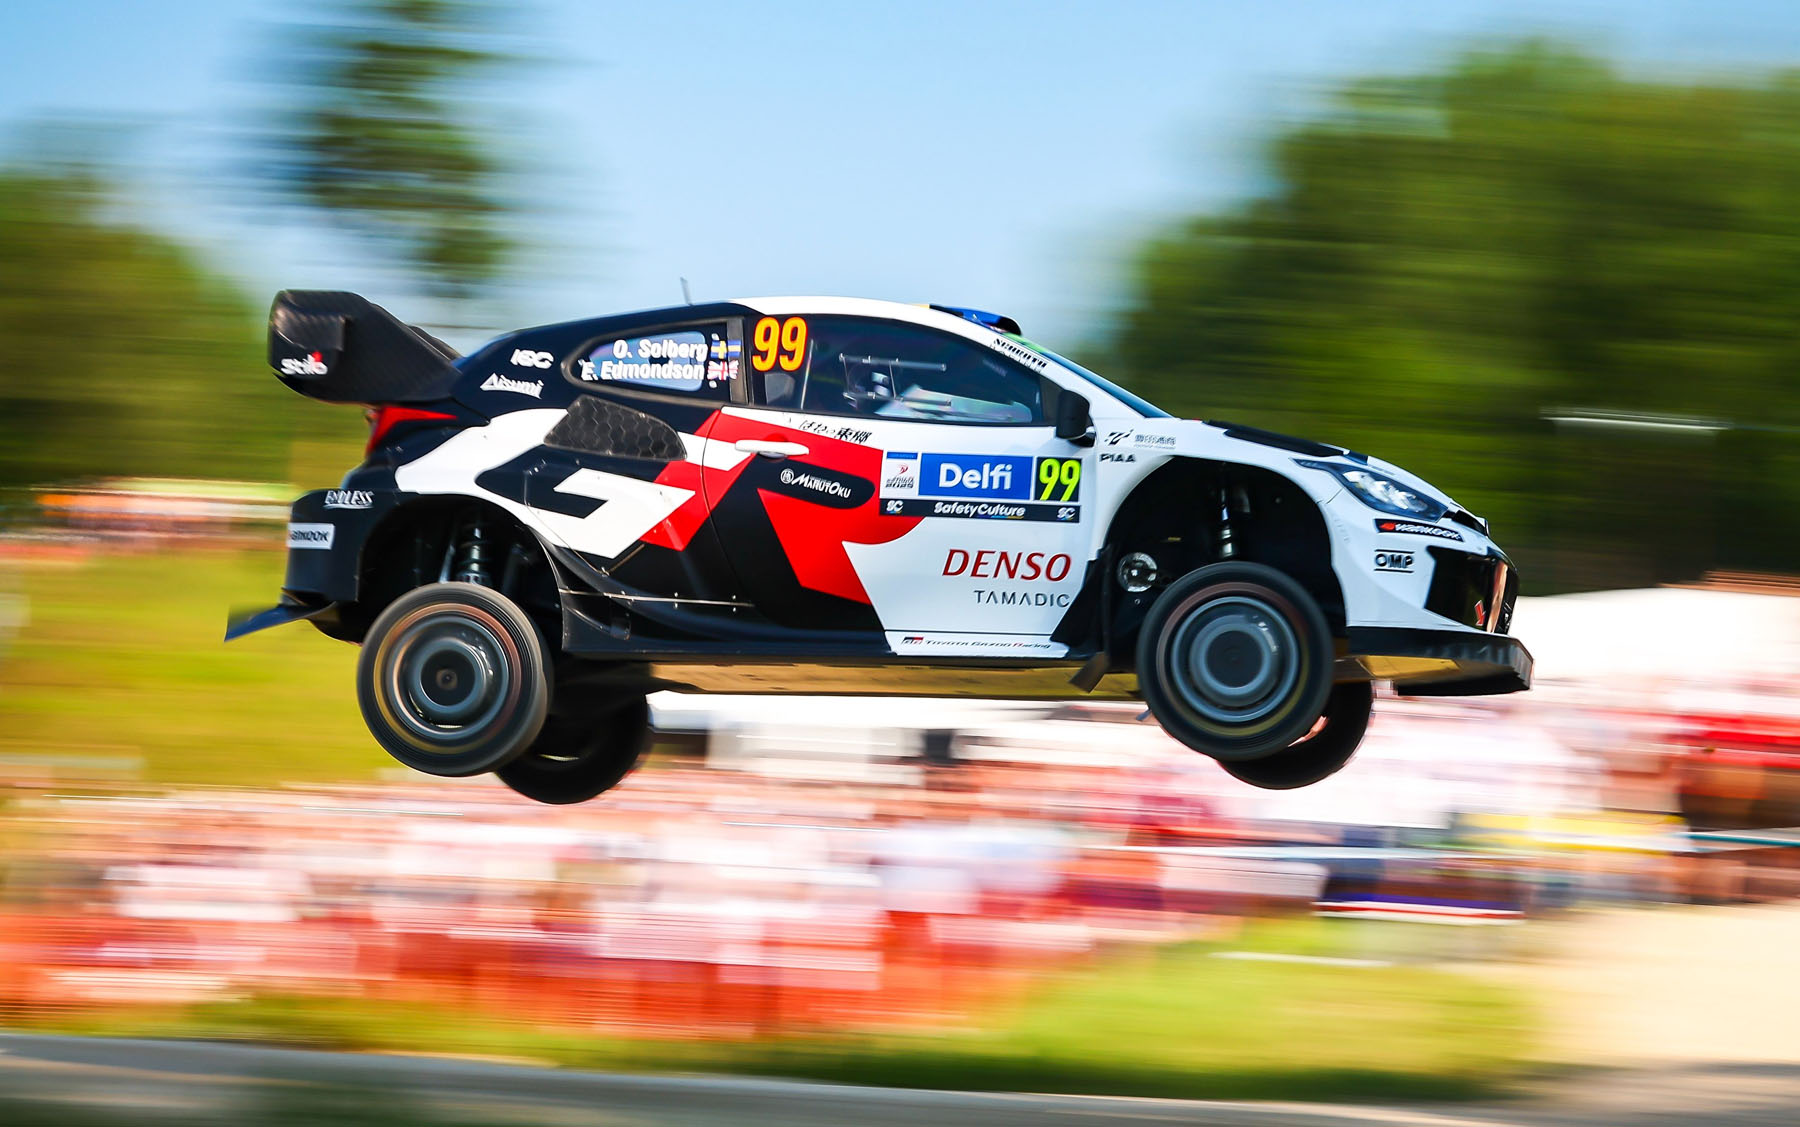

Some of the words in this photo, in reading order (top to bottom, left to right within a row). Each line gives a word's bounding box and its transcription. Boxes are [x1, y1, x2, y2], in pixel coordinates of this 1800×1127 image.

[612, 339, 632, 358] O.
[638, 339, 708, 362] Solberg
[752, 316, 808, 371] 99
[581, 361, 598, 381] E.
[600, 360, 704, 380] Edmondson
[938, 462, 1013, 490] Delfi
[1039, 458, 1081, 501] 99
[934, 502, 1026, 517] SafetyCulture
[942, 549, 1072, 581] DENSO
[1375, 553, 1413, 569] OMP
[973, 590, 1070, 607] TAMADIC
